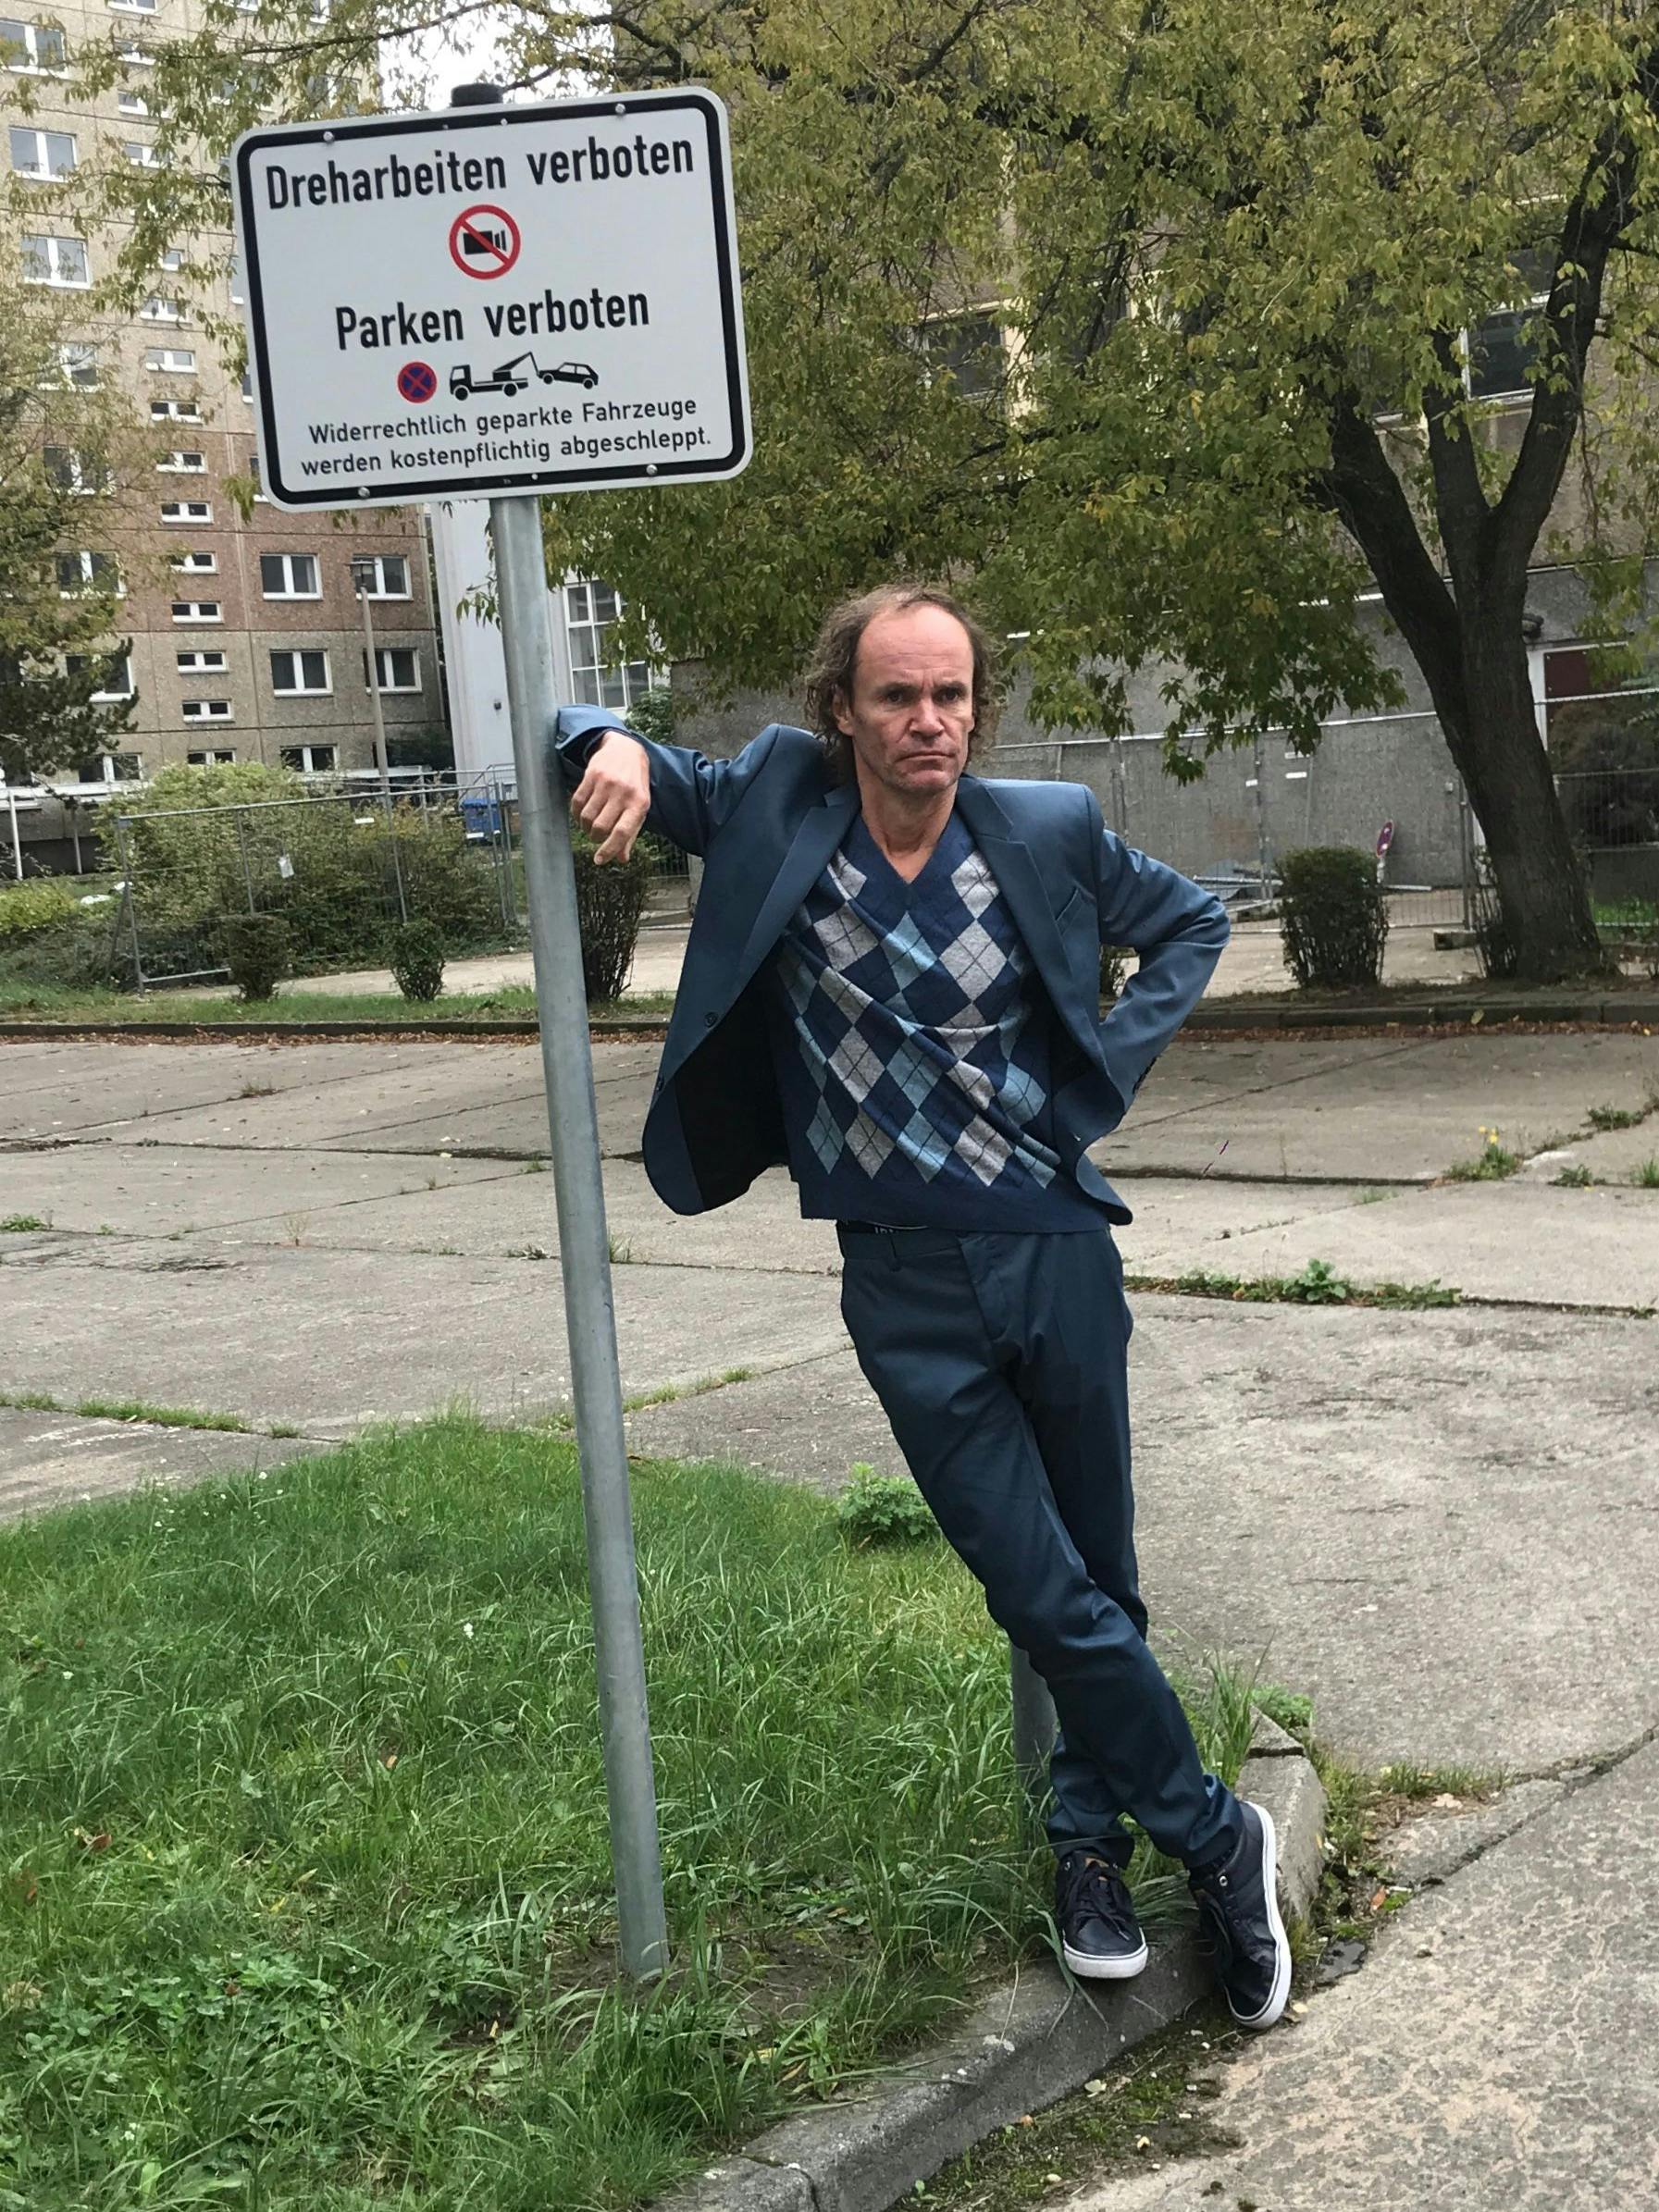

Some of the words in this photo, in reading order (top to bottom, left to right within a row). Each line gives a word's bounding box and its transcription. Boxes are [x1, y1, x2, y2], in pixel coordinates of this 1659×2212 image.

[266, 149, 507, 210] Dreharbeiten
[526, 135, 694, 186] verboten
[335, 301, 464, 351] Parken
[483, 288, 650, 338] verboten
[308, 414, 467, 445] Widerrechtlich
[476, 405, 574, 437] geparkte
[582, 400, 697, 423] Fahrzeuge
[301, 452, 381, 476] werden
[390, 439, 551, 469] kostenpflichtig
[561, 426, 712, 456] abgeschleppt.
